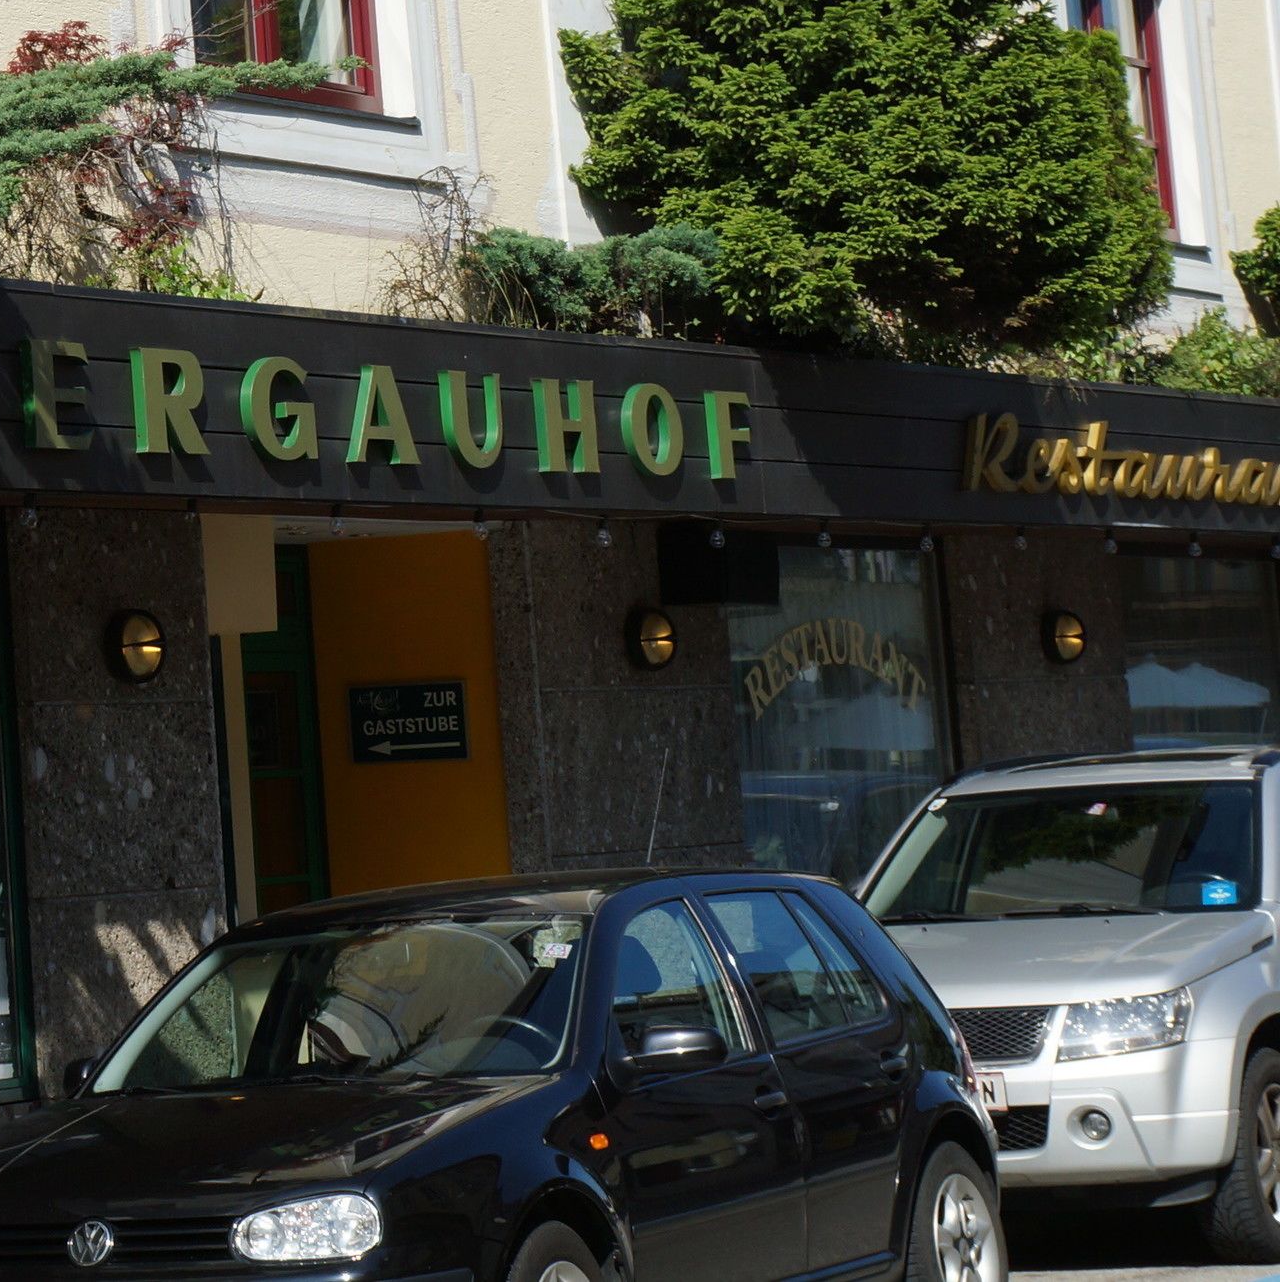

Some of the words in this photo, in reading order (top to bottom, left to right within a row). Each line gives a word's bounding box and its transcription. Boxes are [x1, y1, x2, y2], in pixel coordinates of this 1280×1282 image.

[960, 412, 1280, 507] Restaura
[744, 617, 927, 721] RESTAURANT
[362, 715, 459, 736] GASTSTUBE
[423, 690, 457, 708] ZUR
